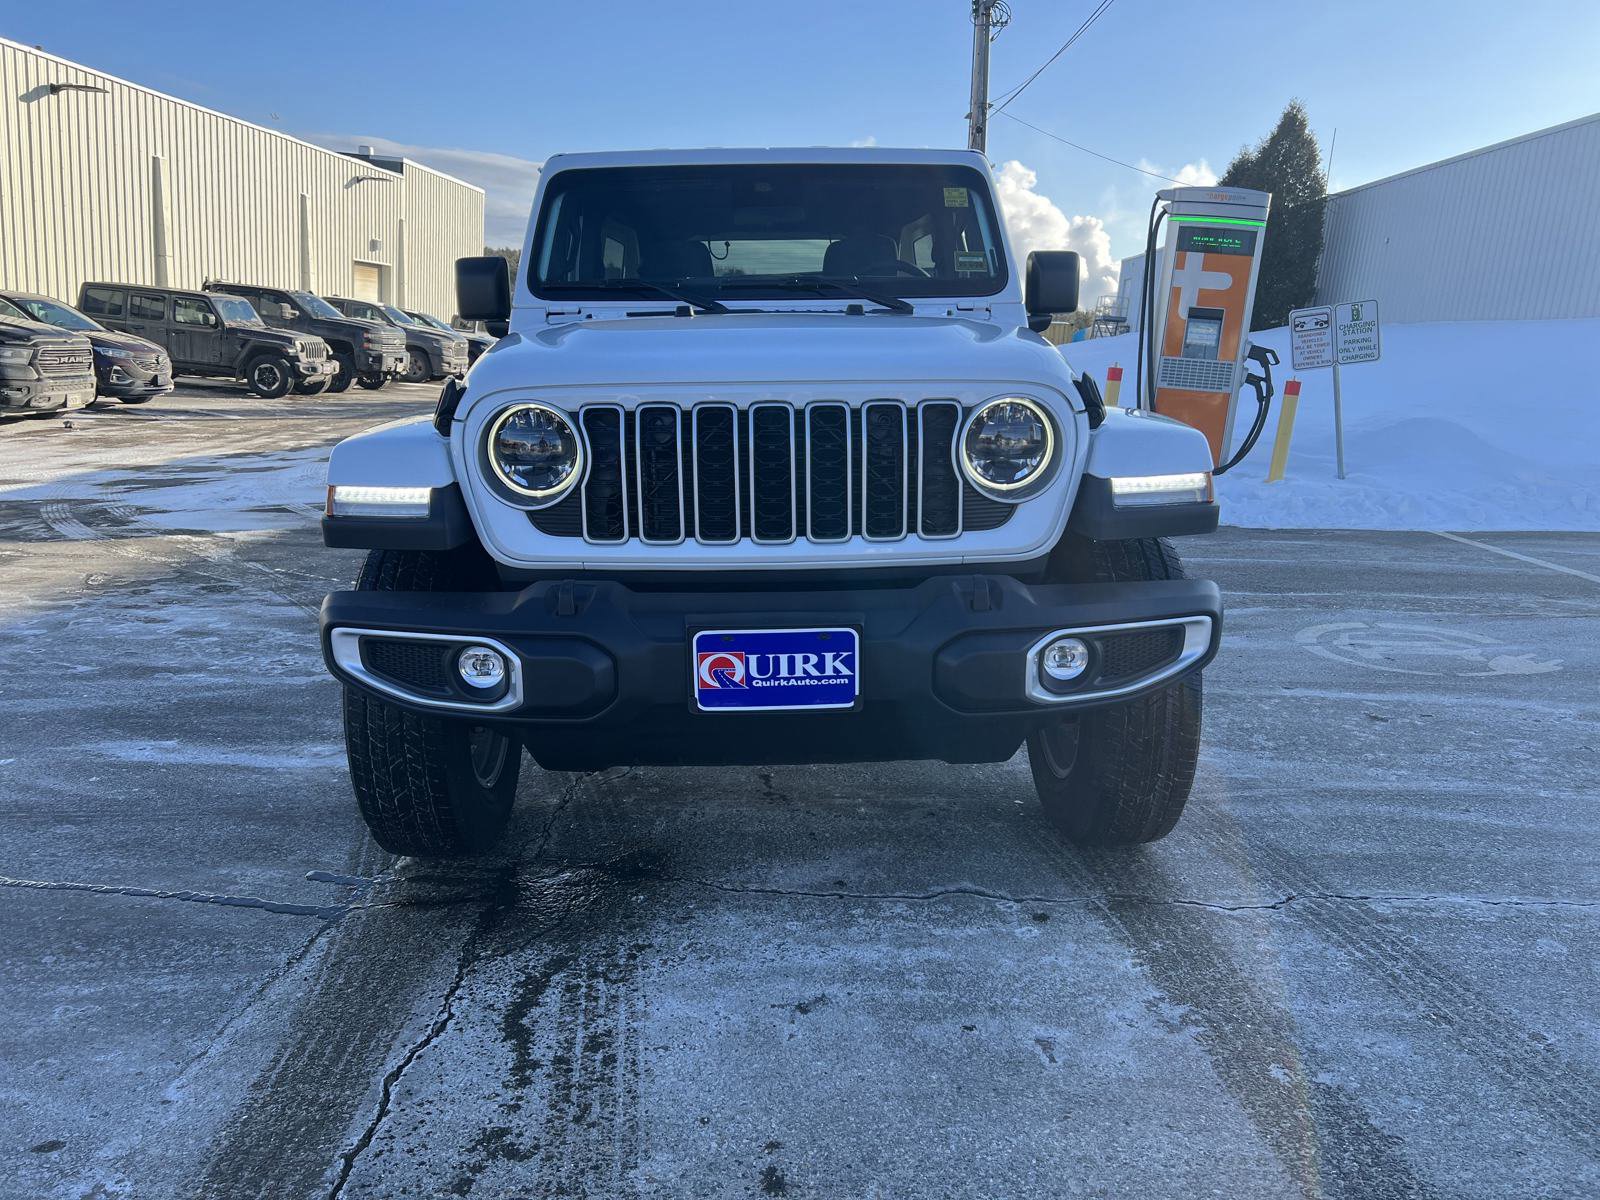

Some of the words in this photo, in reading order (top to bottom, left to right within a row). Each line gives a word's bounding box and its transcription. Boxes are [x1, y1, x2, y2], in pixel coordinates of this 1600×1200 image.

[1339, 321, 1376, 330] CHARGING
[1342, 327, 1372, 336] STATION
[1338, 346, 1356, 354] ONLY
[1358, 344, 1377, 352] WHILE
[59, 356, 84, 364] RAM
[1341, 352, 1376, 361] CHARGING
[699, 652, 854, 688] QUIRK
[752, 677, 849, 688] QuirkAuto.com
